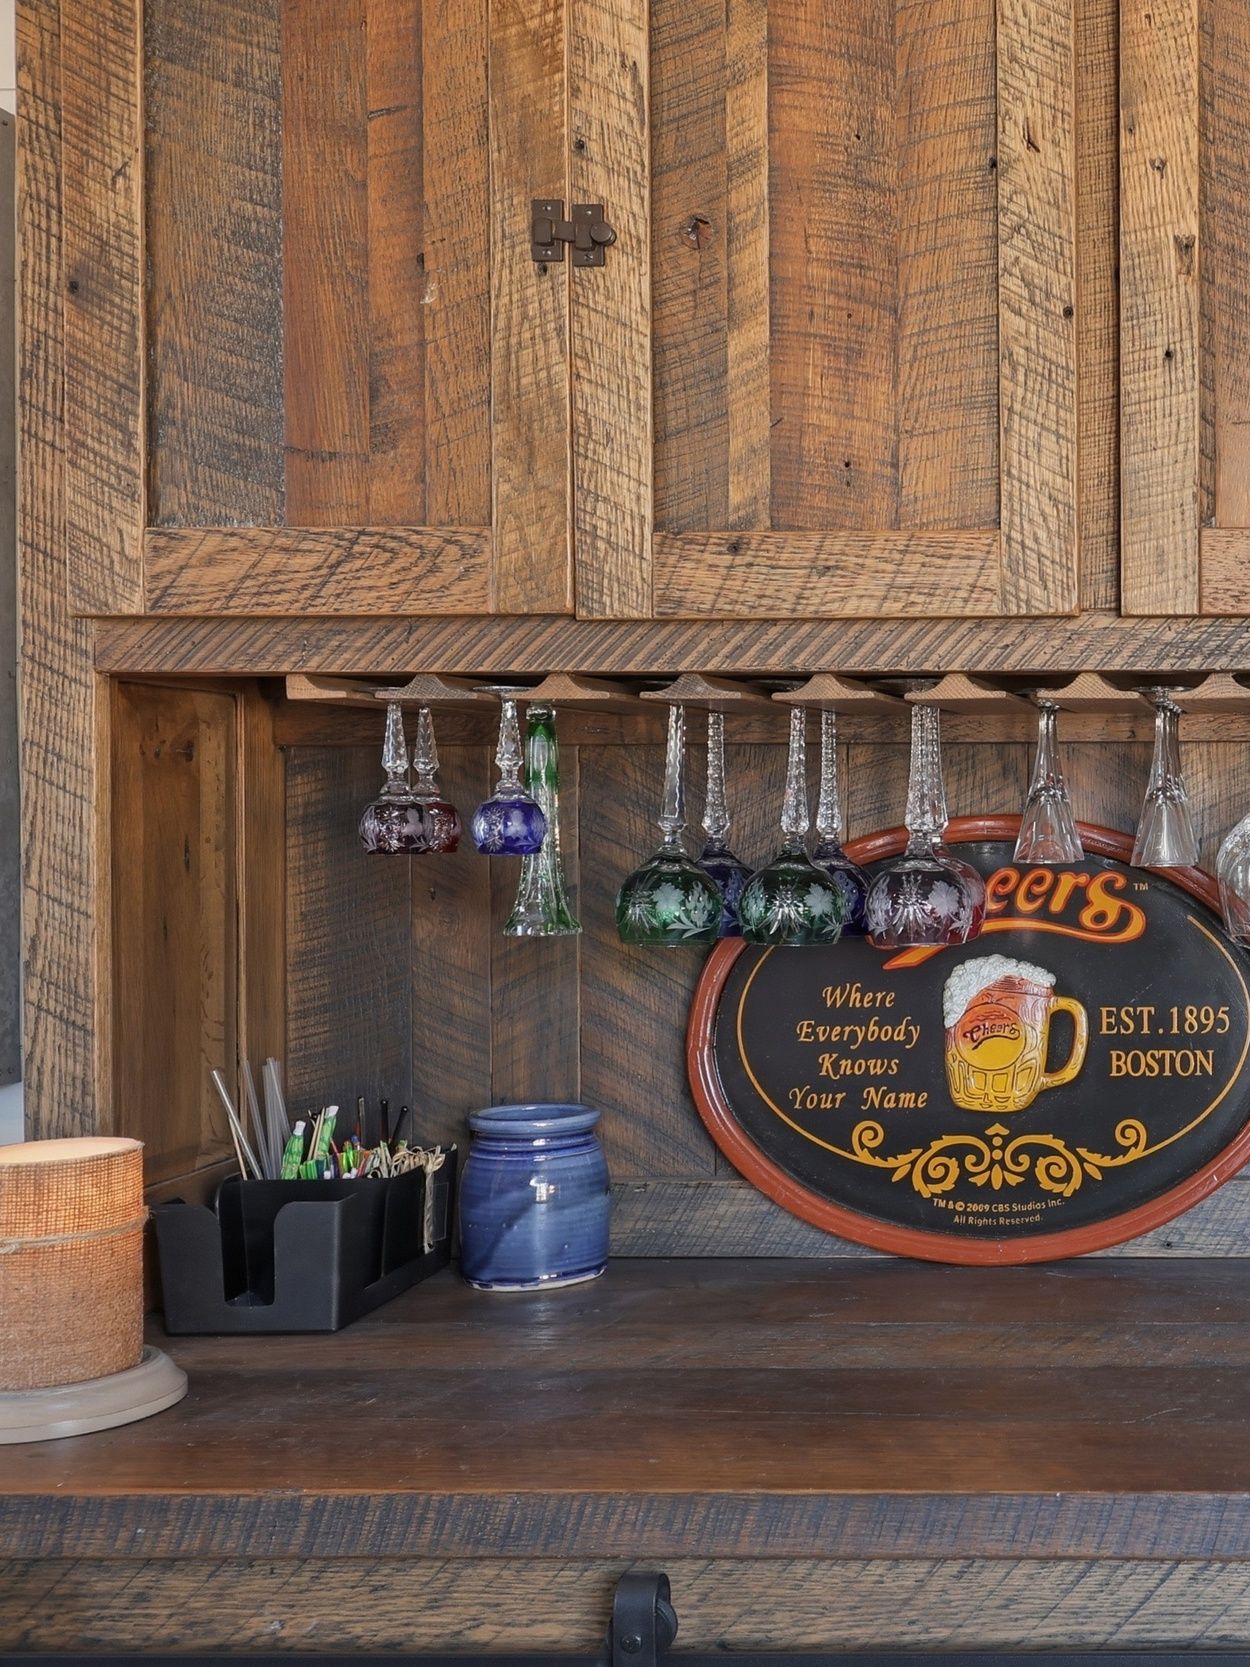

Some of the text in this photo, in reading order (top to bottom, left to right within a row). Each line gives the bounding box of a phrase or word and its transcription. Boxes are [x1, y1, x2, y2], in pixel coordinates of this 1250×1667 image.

[822, 983, 896, 1009] Where
[796, 1016, 921, 1050] Everybody
[962, 1022, 1021, 1050] Cheers
[818, 1053, 900, 1080] Knows
[1109, 1050, 1215, 1077] BOSTON
[788, 1085, 929, 1111] Your Name
[966, 1201, 990, 1213] 2009
[991, 1202, 1011, 1213] CBS
[1011, 1200, 1047, 1212] Studios
[953, 1214, 966, 1225] All
[967, 1216, 997, 1228] Rights
